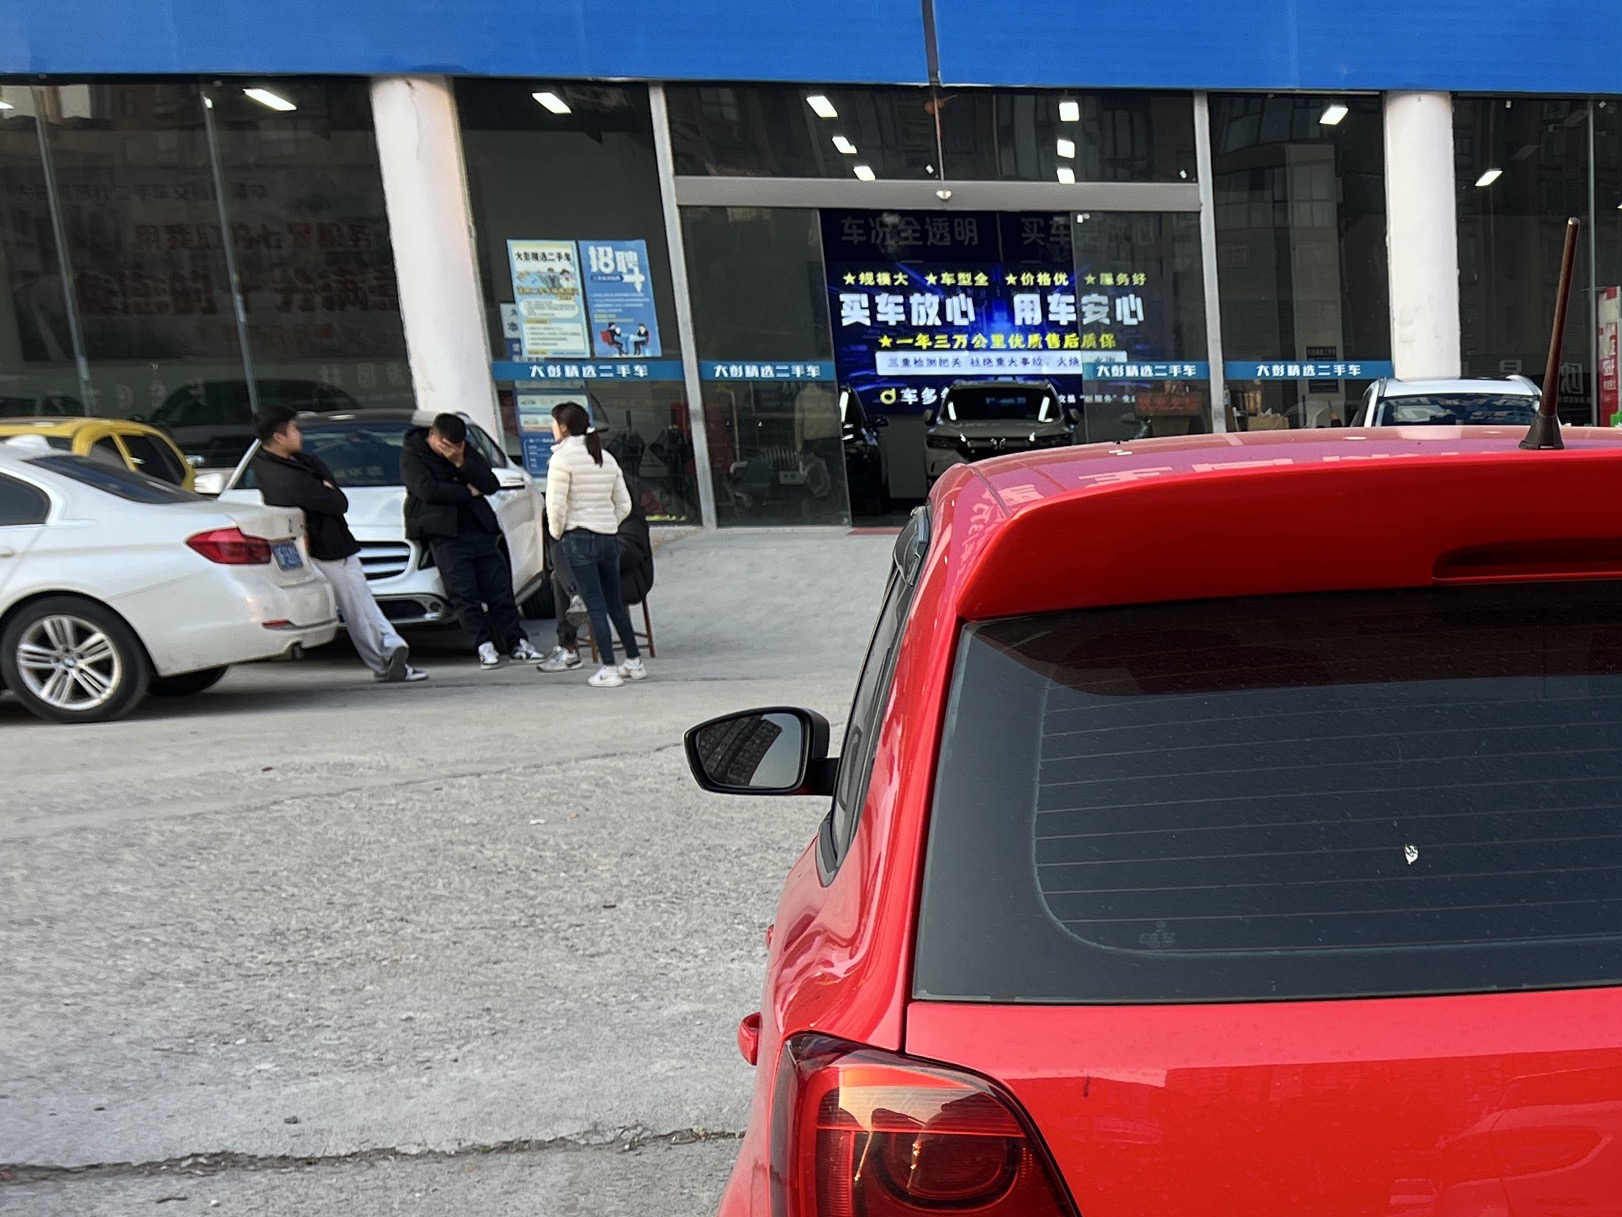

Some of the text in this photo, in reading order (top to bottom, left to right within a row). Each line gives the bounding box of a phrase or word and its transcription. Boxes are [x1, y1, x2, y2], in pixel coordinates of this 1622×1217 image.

[839, 293, 1145, 326] 买车放心 用车安心
[529, 364, 649, 378] 大彭精选二手车
[713, 364, 821, 378] 大彭精选二手车
[1096, 364, 1198, 377] 大彭精选二手车
[1256, 364, 1362, 377] 大彭精选二手车
